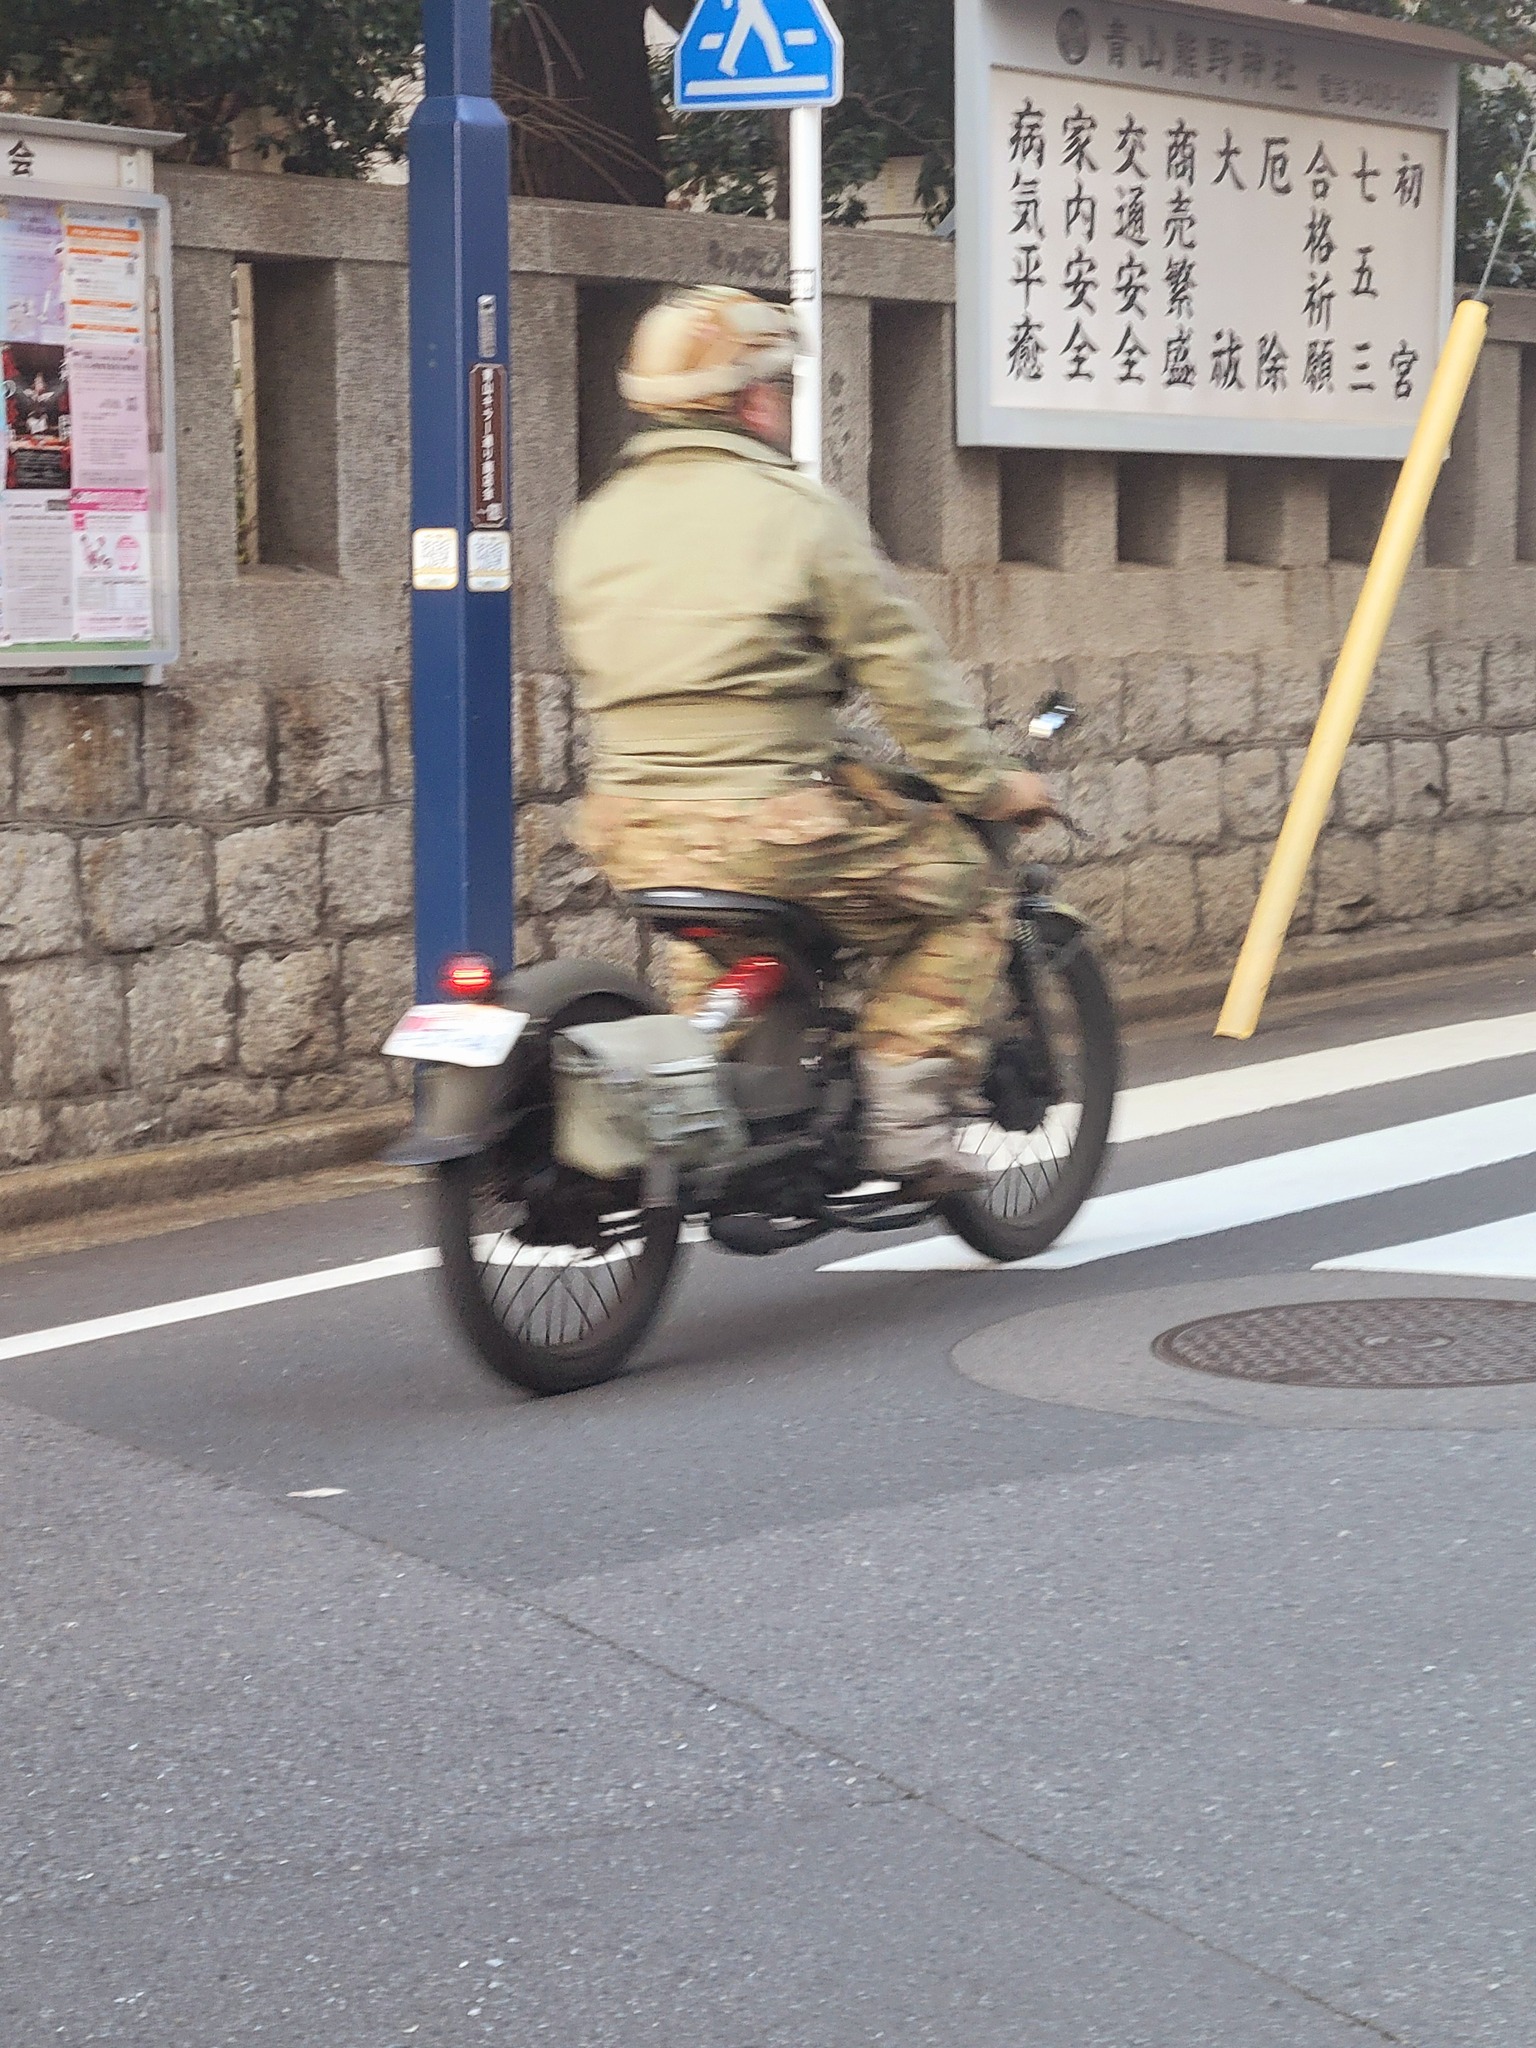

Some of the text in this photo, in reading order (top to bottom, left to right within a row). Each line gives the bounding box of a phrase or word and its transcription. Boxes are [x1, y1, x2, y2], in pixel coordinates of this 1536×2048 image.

[8, 140, 35, 177] 会
[1007, 98, 1049, 380] 病気平癒
[1060, 103, 1100, 382] 家内安全
[1112, 113, 1151, 384] 交通安全
[1163, 119, 1198, 389] 商売繁盛
[1302, 141, 1338, 393] 合格祈願
